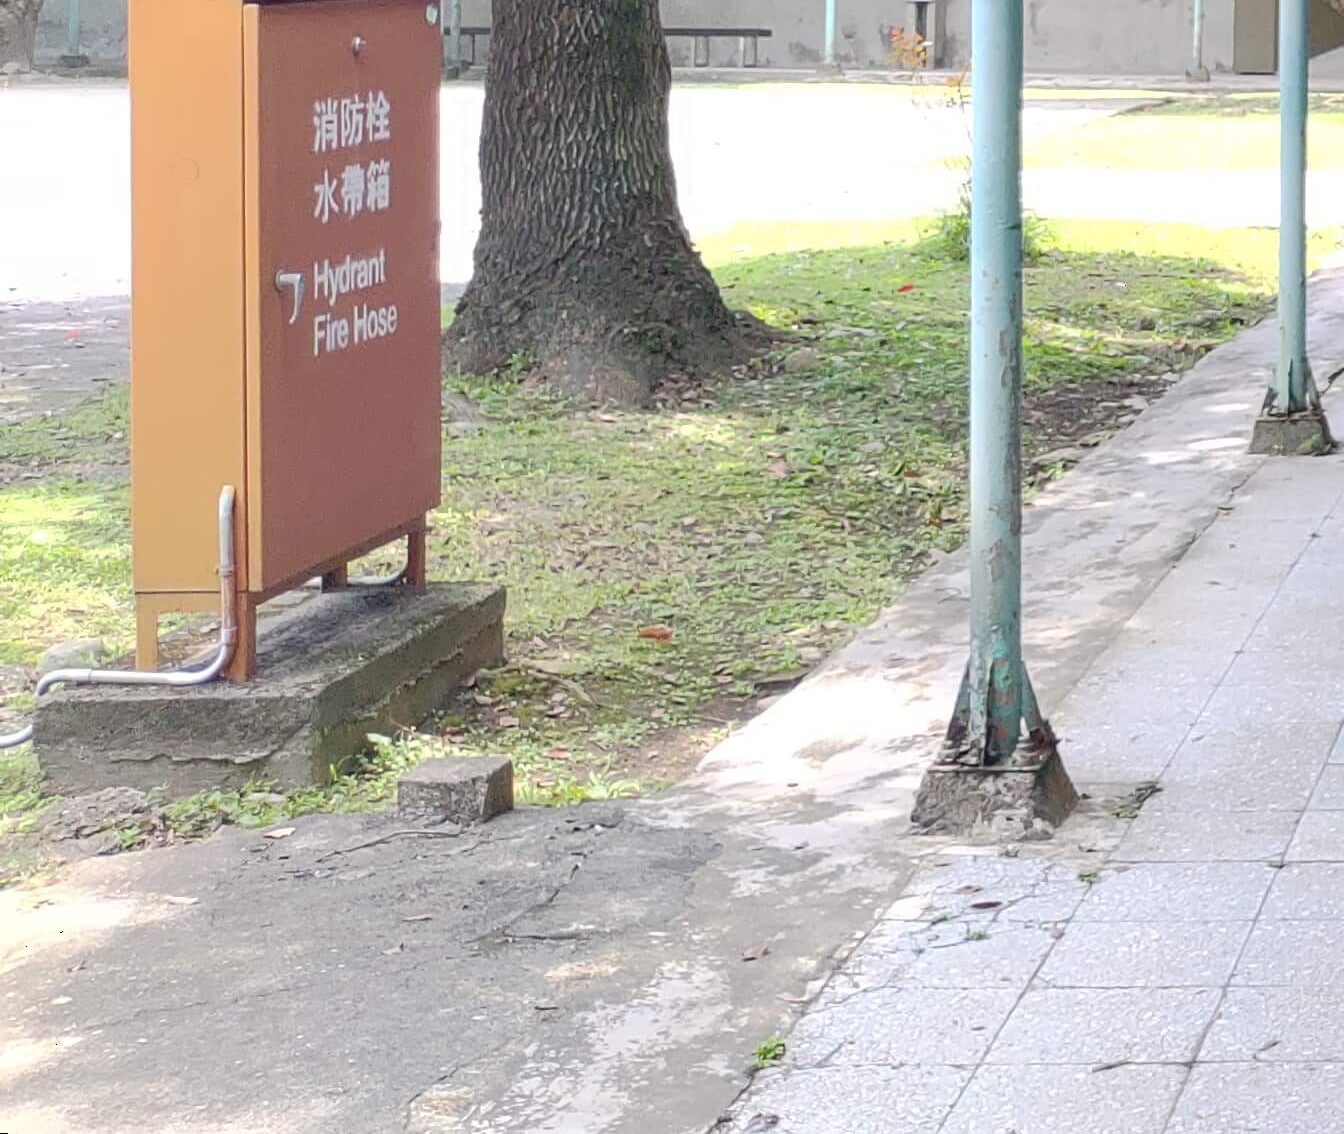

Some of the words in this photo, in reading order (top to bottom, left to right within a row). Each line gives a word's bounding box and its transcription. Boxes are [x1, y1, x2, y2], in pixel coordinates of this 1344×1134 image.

[313, 90, 390, 153] 消防栓
[313, 159, 390, 224] 水帶箱
[314, 249, 386, 306] Hydrant
[313, 312, 349, 356] Fire
[353, 303, 398, 344] Hose
